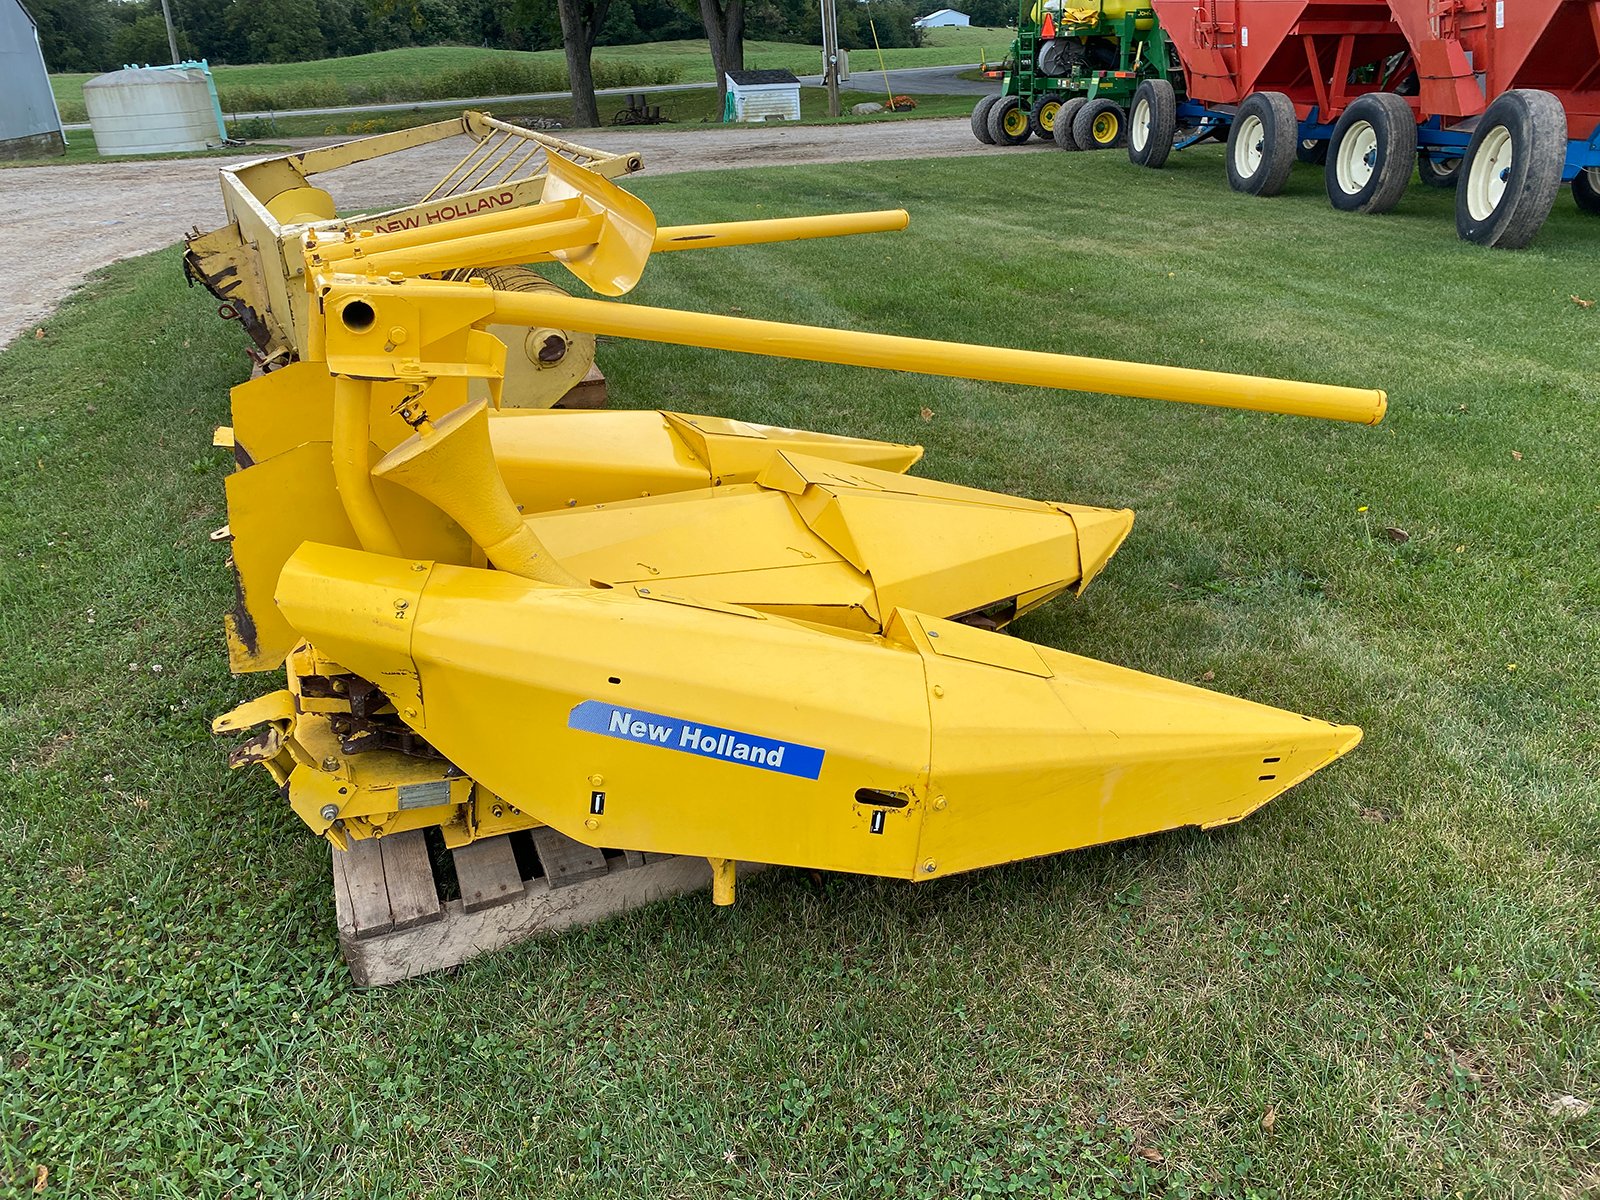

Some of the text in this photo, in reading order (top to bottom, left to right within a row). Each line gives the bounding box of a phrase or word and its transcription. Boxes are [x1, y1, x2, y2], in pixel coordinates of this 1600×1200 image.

[375, 192, 514, 235] NEW HOLLAND
[608, 709, 786, 768] New Holland
